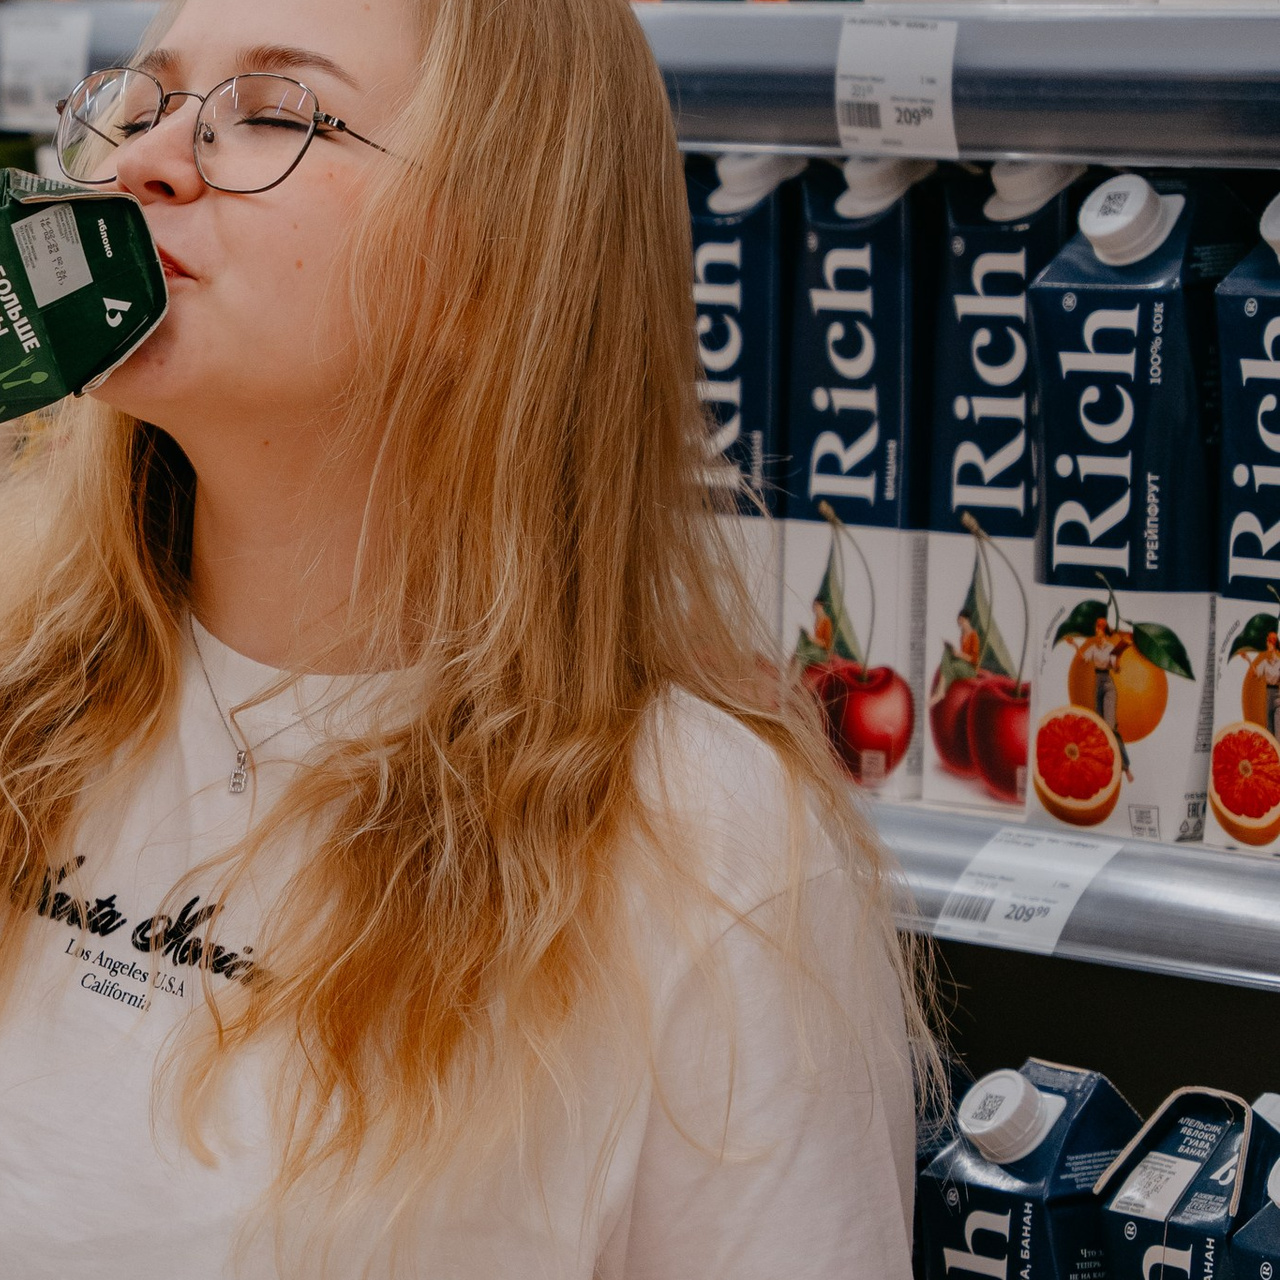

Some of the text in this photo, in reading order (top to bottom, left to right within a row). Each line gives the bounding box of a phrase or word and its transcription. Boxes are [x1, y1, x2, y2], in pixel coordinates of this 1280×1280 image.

[95, 218, 114, 258] яблоко
[808, 241, 879, 507] Rich
[952, 246, 1028, 517] Rich
[1149, 335, 1163, 385] 100%
[1052, 302, 1140, 578] Rich
[1144, 472, 1160, 570] ГРЕЙПФРУТ
[64, 938, 186, 998] Los Angeles U.S.A
[80, 972, 151, 1013] California
[1178, 1116, 1223, 1135] АПЕЛЬСИН,
[1180, 1126, 1217, 1143] ЯБЛОКО,
[1183, 1136, 1211, 1150] ГУАВА,
[1020, 1202, 1033, 1260] БАНАН
